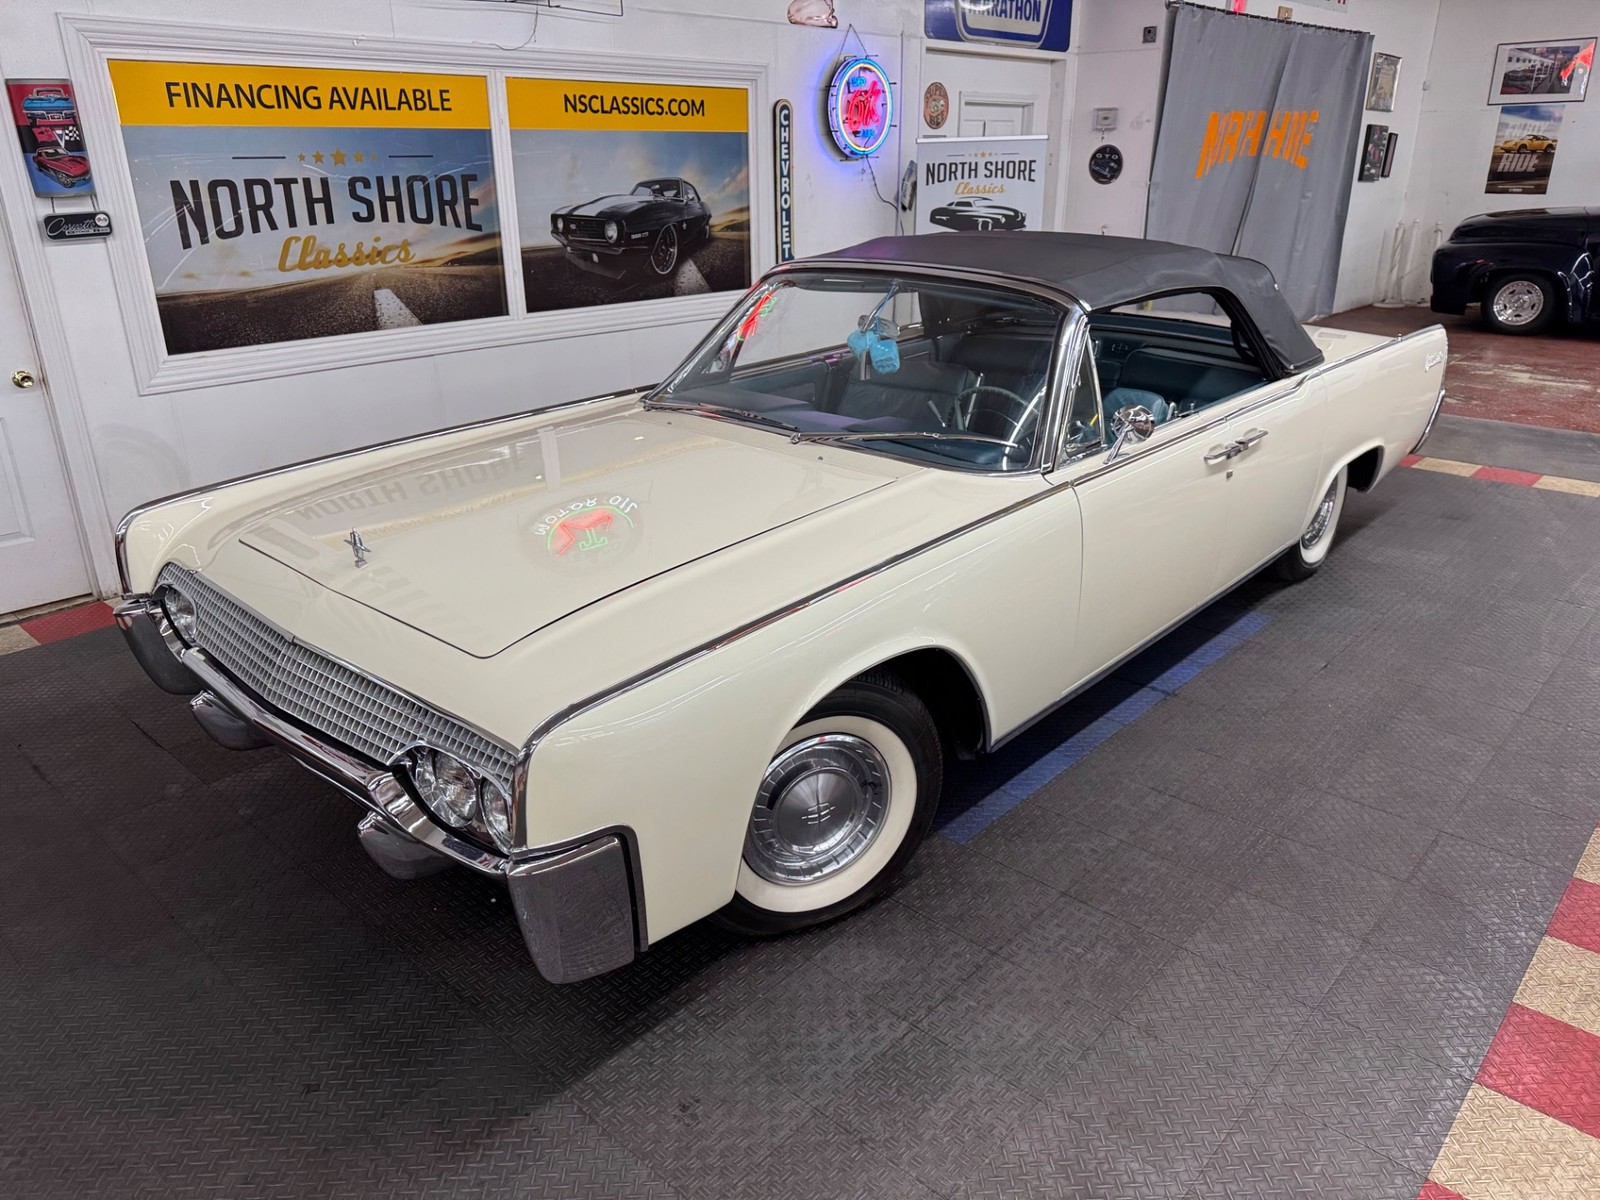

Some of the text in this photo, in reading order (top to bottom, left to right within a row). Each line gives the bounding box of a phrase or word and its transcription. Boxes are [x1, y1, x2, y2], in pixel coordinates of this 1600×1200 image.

[164, 81, 453, 112] FINANCING AVAILABLE
[563, 93, 706, 117] NSCLASSICS.COM
[925, 159, 1037, 186] NORTH SHORE
[1497, 153, 1540, 173] RIDE
[779, 109, 791, 258] CHEVROLET
[954, 182, 1006, 196] Classics
[169, 173, 483, 250] NORTH SHORE
[278, 234, 416, 274] Classics
